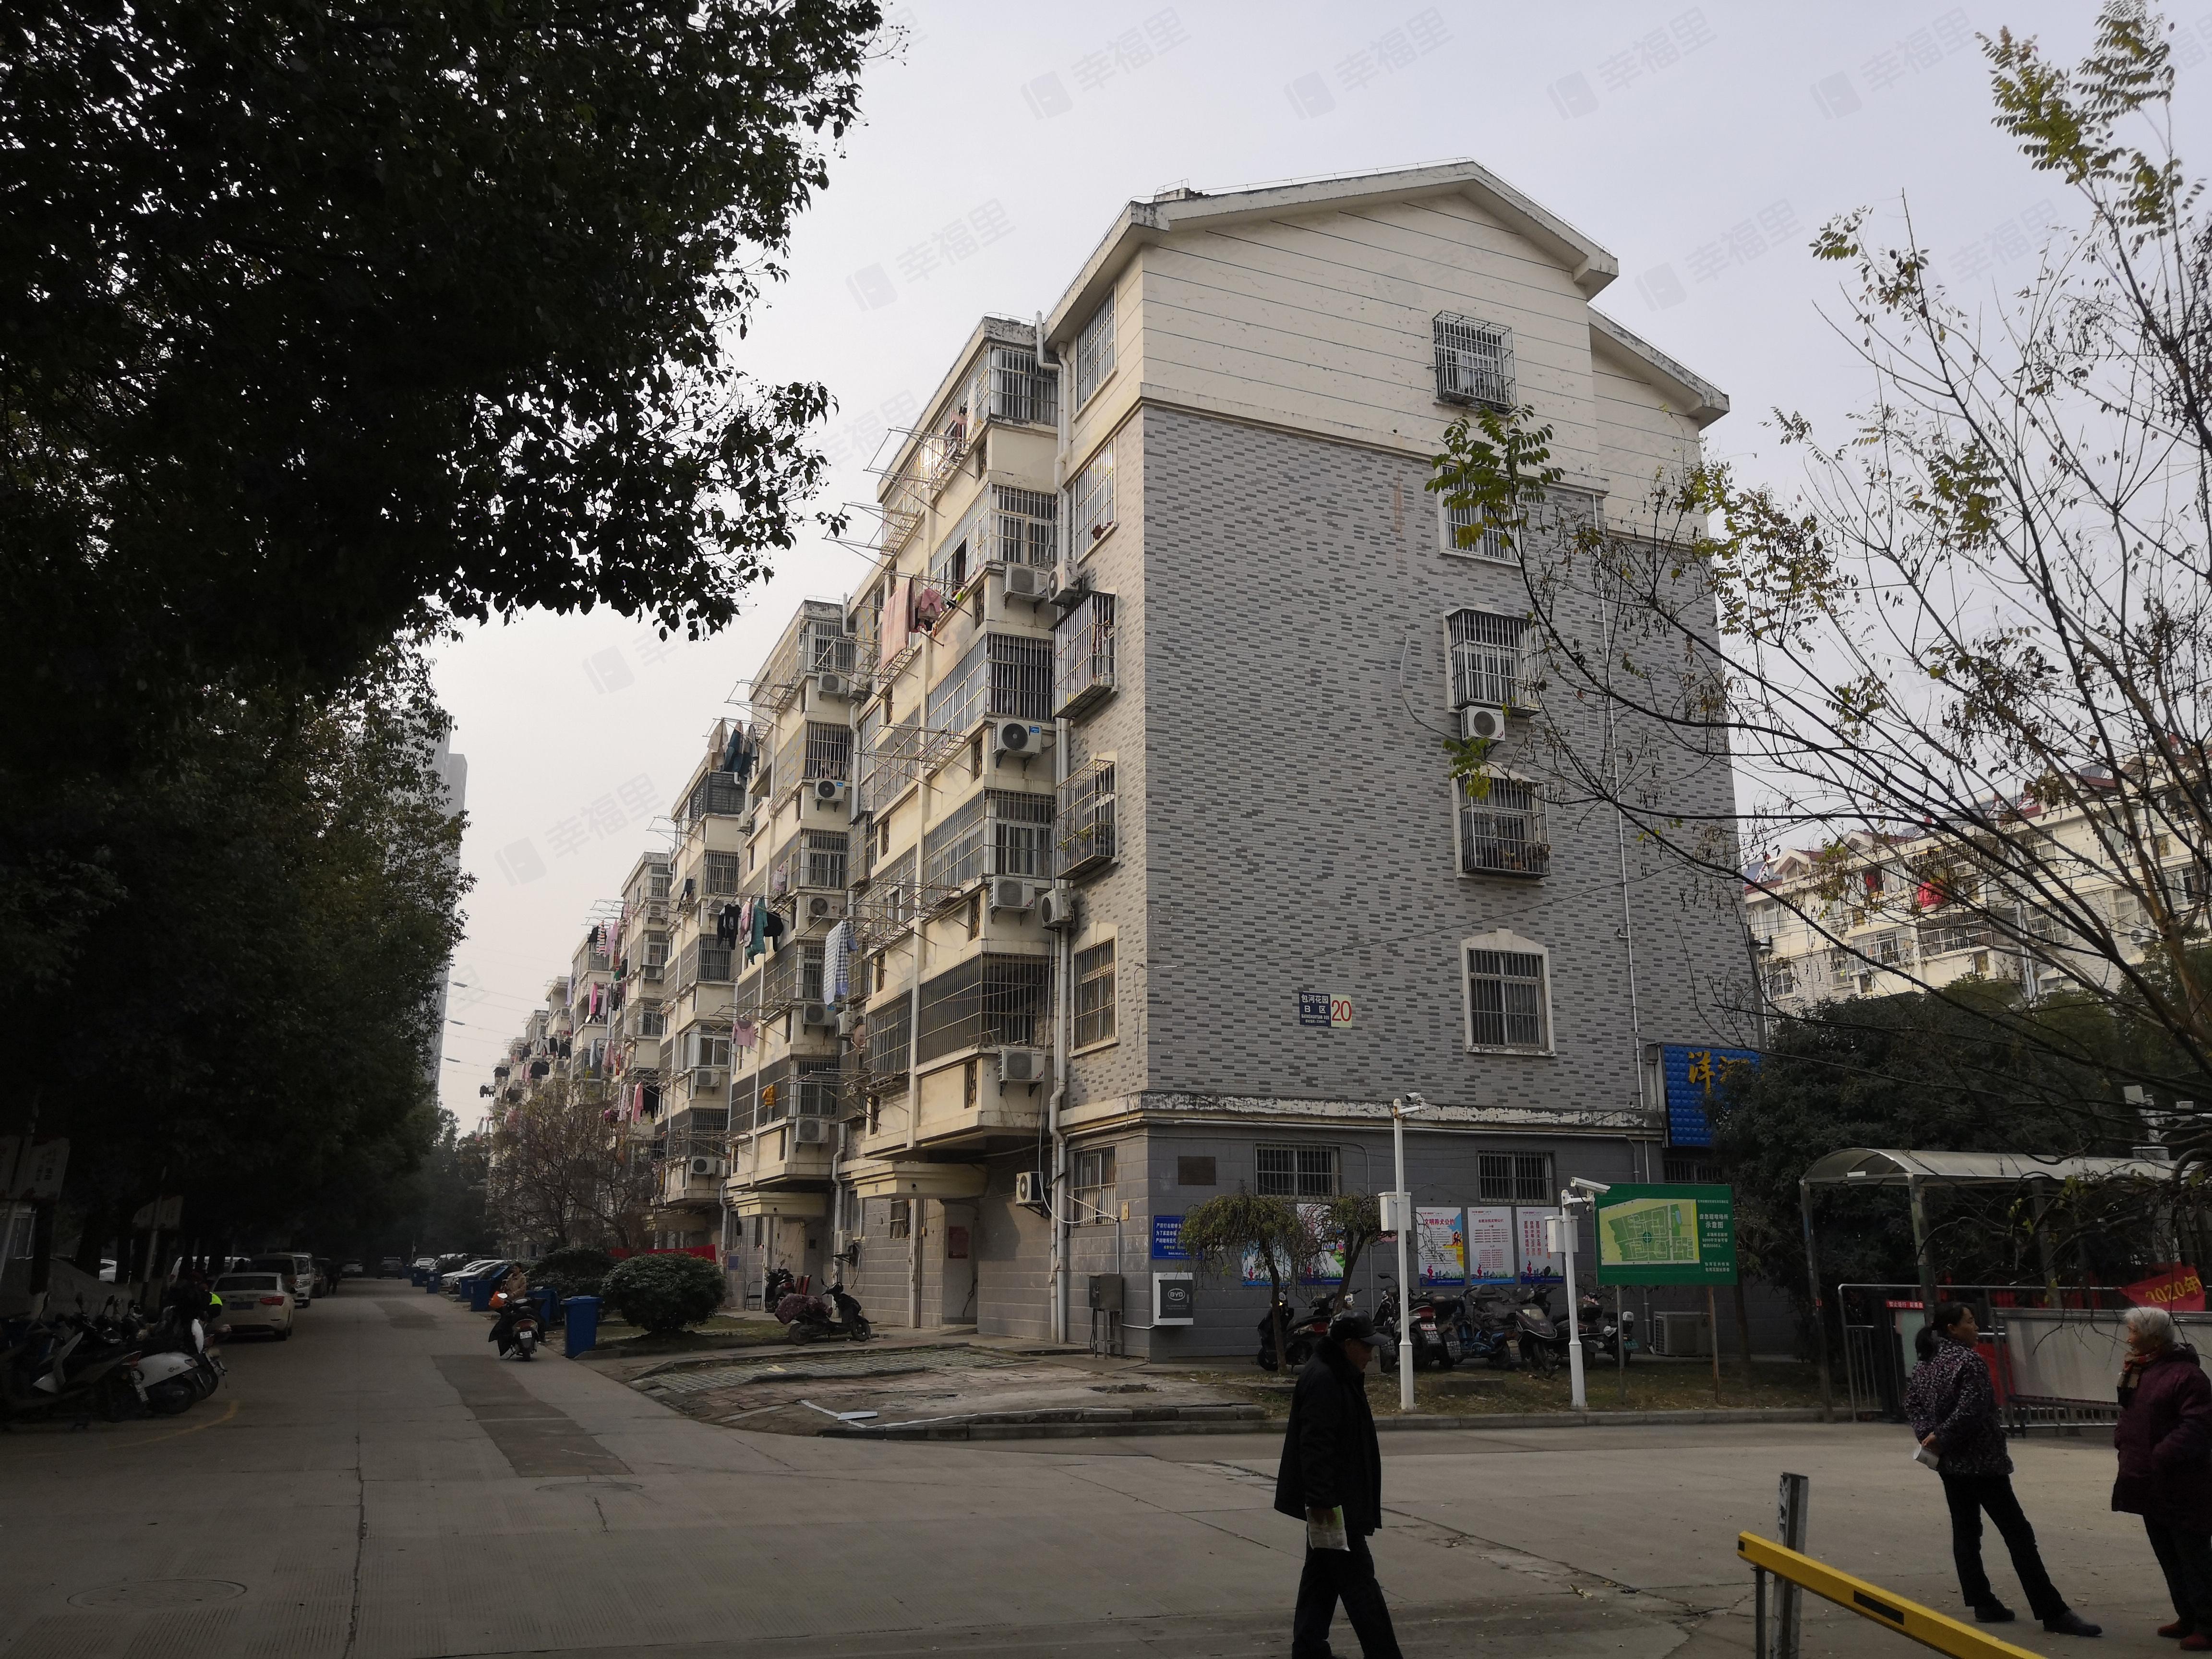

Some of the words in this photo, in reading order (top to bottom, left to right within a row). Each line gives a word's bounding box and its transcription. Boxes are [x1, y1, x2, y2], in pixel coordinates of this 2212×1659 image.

[1301, 994, 1329, 1004] 包河花园
[1319, 1005, 1326, 1013] 区
[1332, 1000, 1352, 1022] 20
[2145, 1275, 2202, 1303] 2020年
